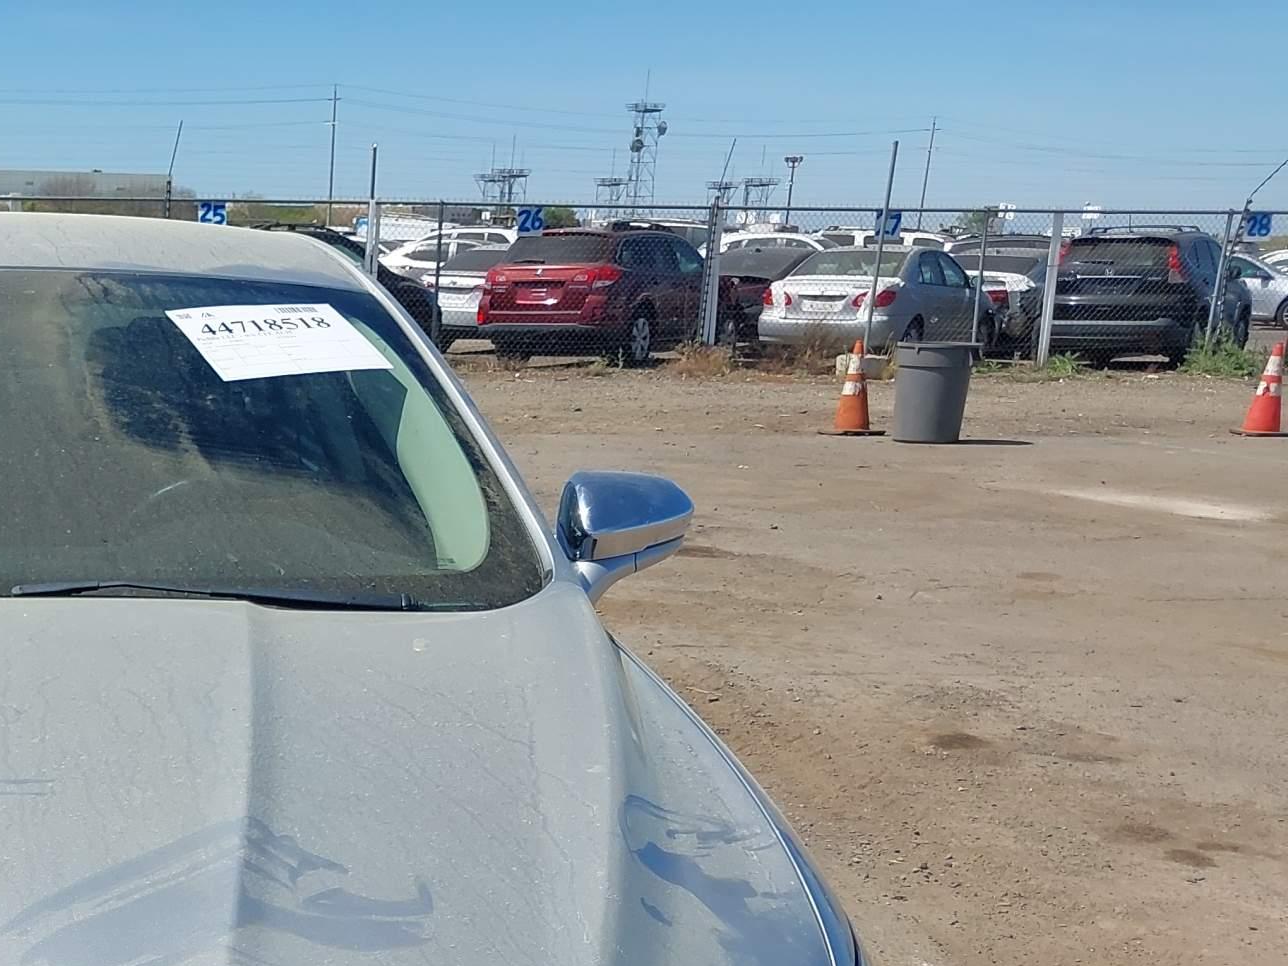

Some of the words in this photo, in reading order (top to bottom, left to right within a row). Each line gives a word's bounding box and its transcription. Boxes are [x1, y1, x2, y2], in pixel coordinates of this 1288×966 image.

[200, 202, 226, 225] 25
[518, 208, 543, 232] 26
[1247, 215, 1271, 237] 28
[201, 317, 331, 336] 44718518
